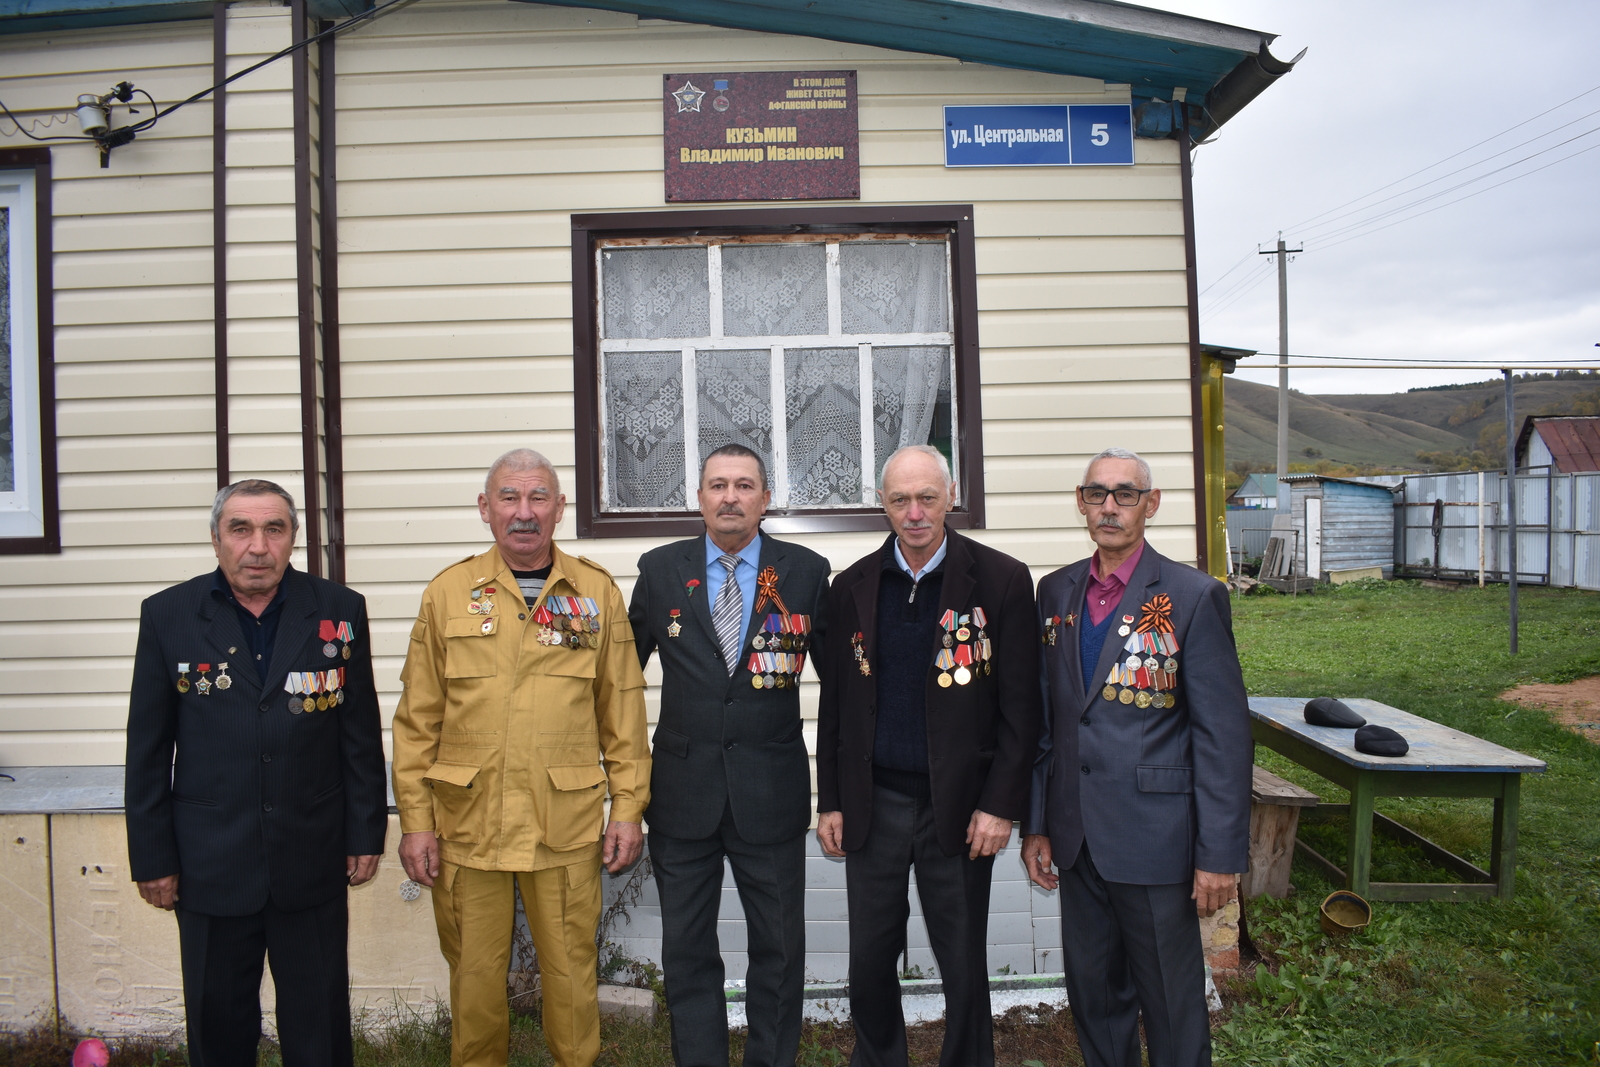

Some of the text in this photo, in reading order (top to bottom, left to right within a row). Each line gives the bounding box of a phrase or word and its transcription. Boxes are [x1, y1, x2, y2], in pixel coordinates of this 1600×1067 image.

[793, 78, 846, 88] В ЭТОМ ДОМЕ
[786, 89, 847, 98] ЖИВЕТ ВЕТЕРАН
[768, 99, 847, 110] АФГАНСКОЙ ВОЙНЫ
[726, 126, 797, 143] КУЗЬМИН
[951, 123, 1110, 149] ул. Центральная 5
[680, 145, 844, 164] Владимир Иванович
